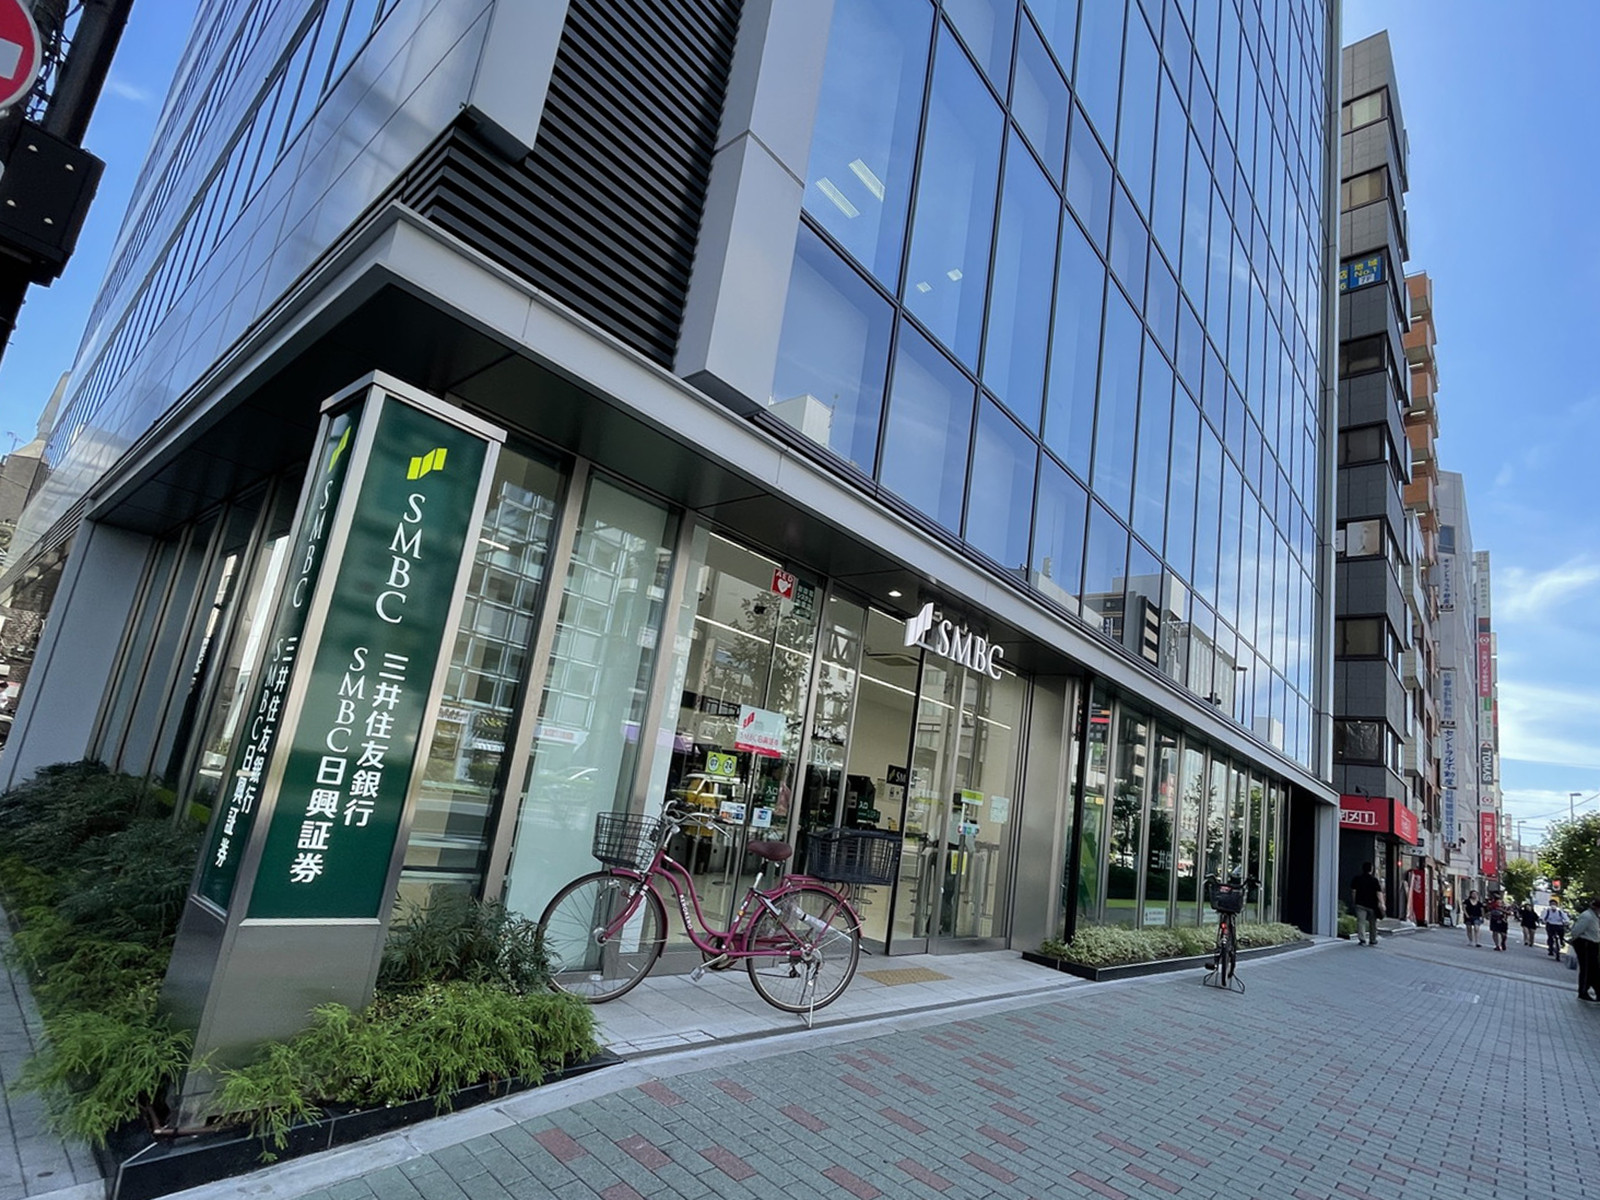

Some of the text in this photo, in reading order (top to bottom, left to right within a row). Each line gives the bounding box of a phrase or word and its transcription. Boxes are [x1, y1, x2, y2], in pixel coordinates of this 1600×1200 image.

[293, 480, 333, 608] SMBC
[375, 493, 426, 624] SMBC
[776, 571, 794, 583] AED
[938, 619, 1004, 680] SMBC
[241, 637, 298, 814] 三井住友銀行
[342, 652, 409, 828] 三井住友銀行
[289, 647, 368, 884] SMBC日興証券
[1443, 729, 1456, 786] セントラル不動産
[1482, 750, 1492, 782] TOMAS
[765, 785, 779, 795] 入口
[858, 800, 869, 809] 入口
